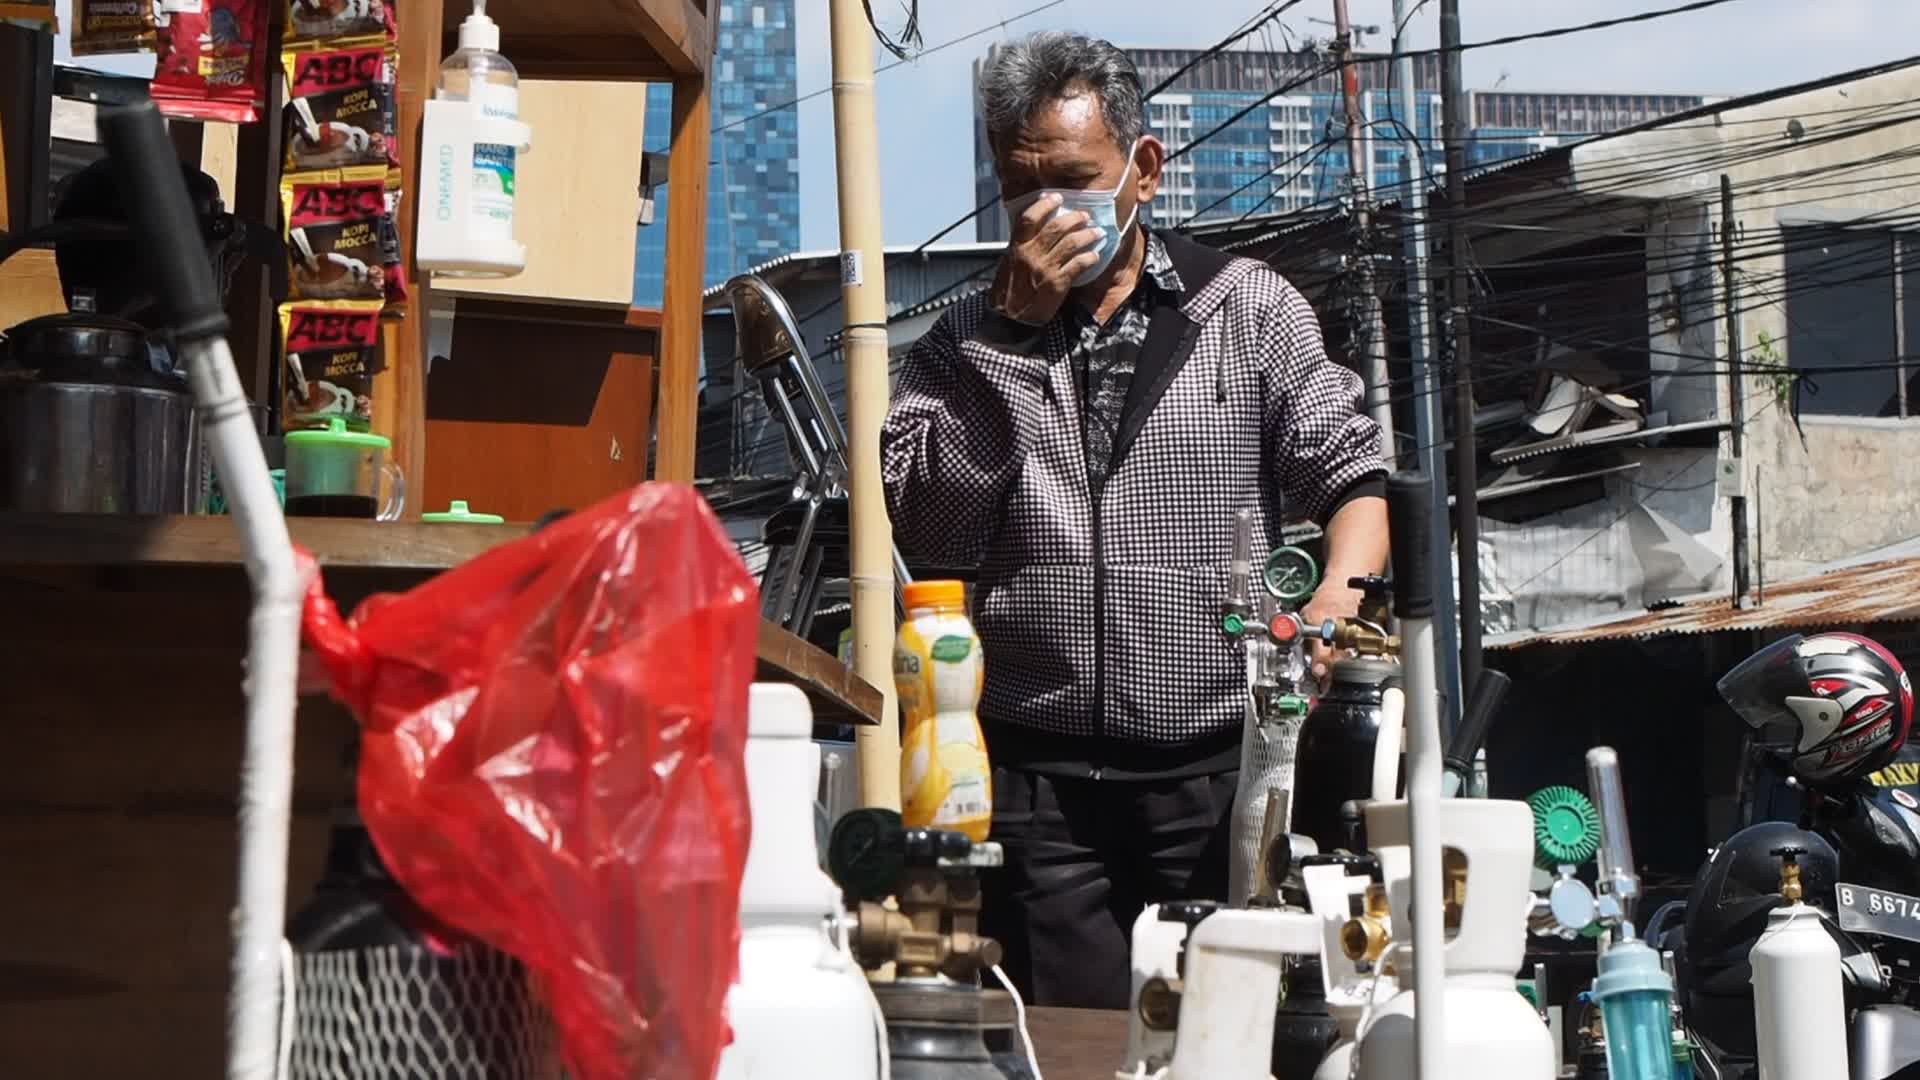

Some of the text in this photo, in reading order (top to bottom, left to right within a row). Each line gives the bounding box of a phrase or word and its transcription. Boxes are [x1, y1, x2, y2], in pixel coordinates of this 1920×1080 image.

[295, 52, 380, 86] ABC
[343, 88, 369, 105] KOPI
[335, 99, 378, 119] MOCCA
[438, 144, 454, 221] ONEMED
[294, 186, 380, 216] ABC
[341, 223, 369, 238] KOPI
[334, 232, 377, 250] MOCCA
[288, 313, 373, 342] ABC
[332, 351, 359, 365] KOPI
[324, 360, 365, 377] MOCCA
[1841, 887, 1920, 920] B 6674
